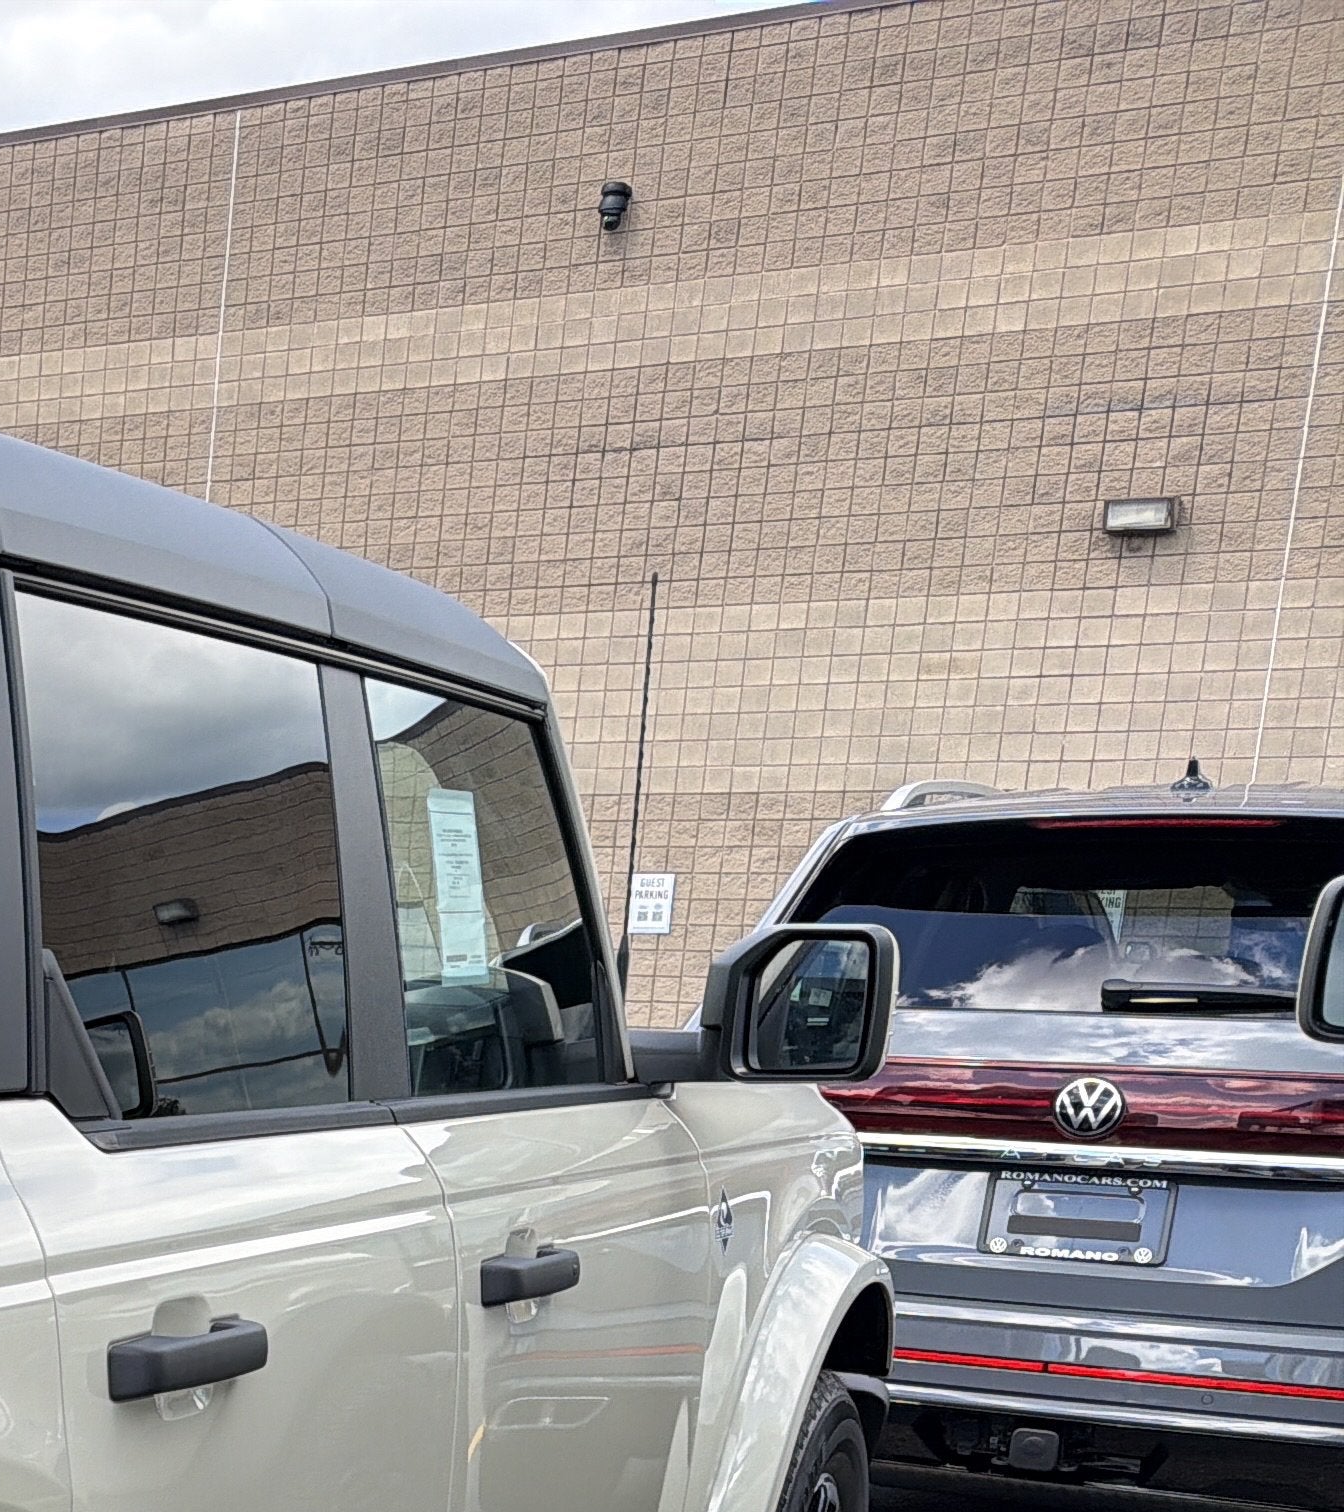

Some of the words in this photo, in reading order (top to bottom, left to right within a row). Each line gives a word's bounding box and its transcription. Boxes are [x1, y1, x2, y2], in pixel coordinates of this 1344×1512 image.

[639, 877, 666, 888] GUEST
[634, 889, 669, 900] PARKING
[1055, 1076, 1123, 1137] VW
[1000, 1170, 1168, 1189] ROMANOCARS.COM
[1019, 1246, 1119, 1262] ROMANO
